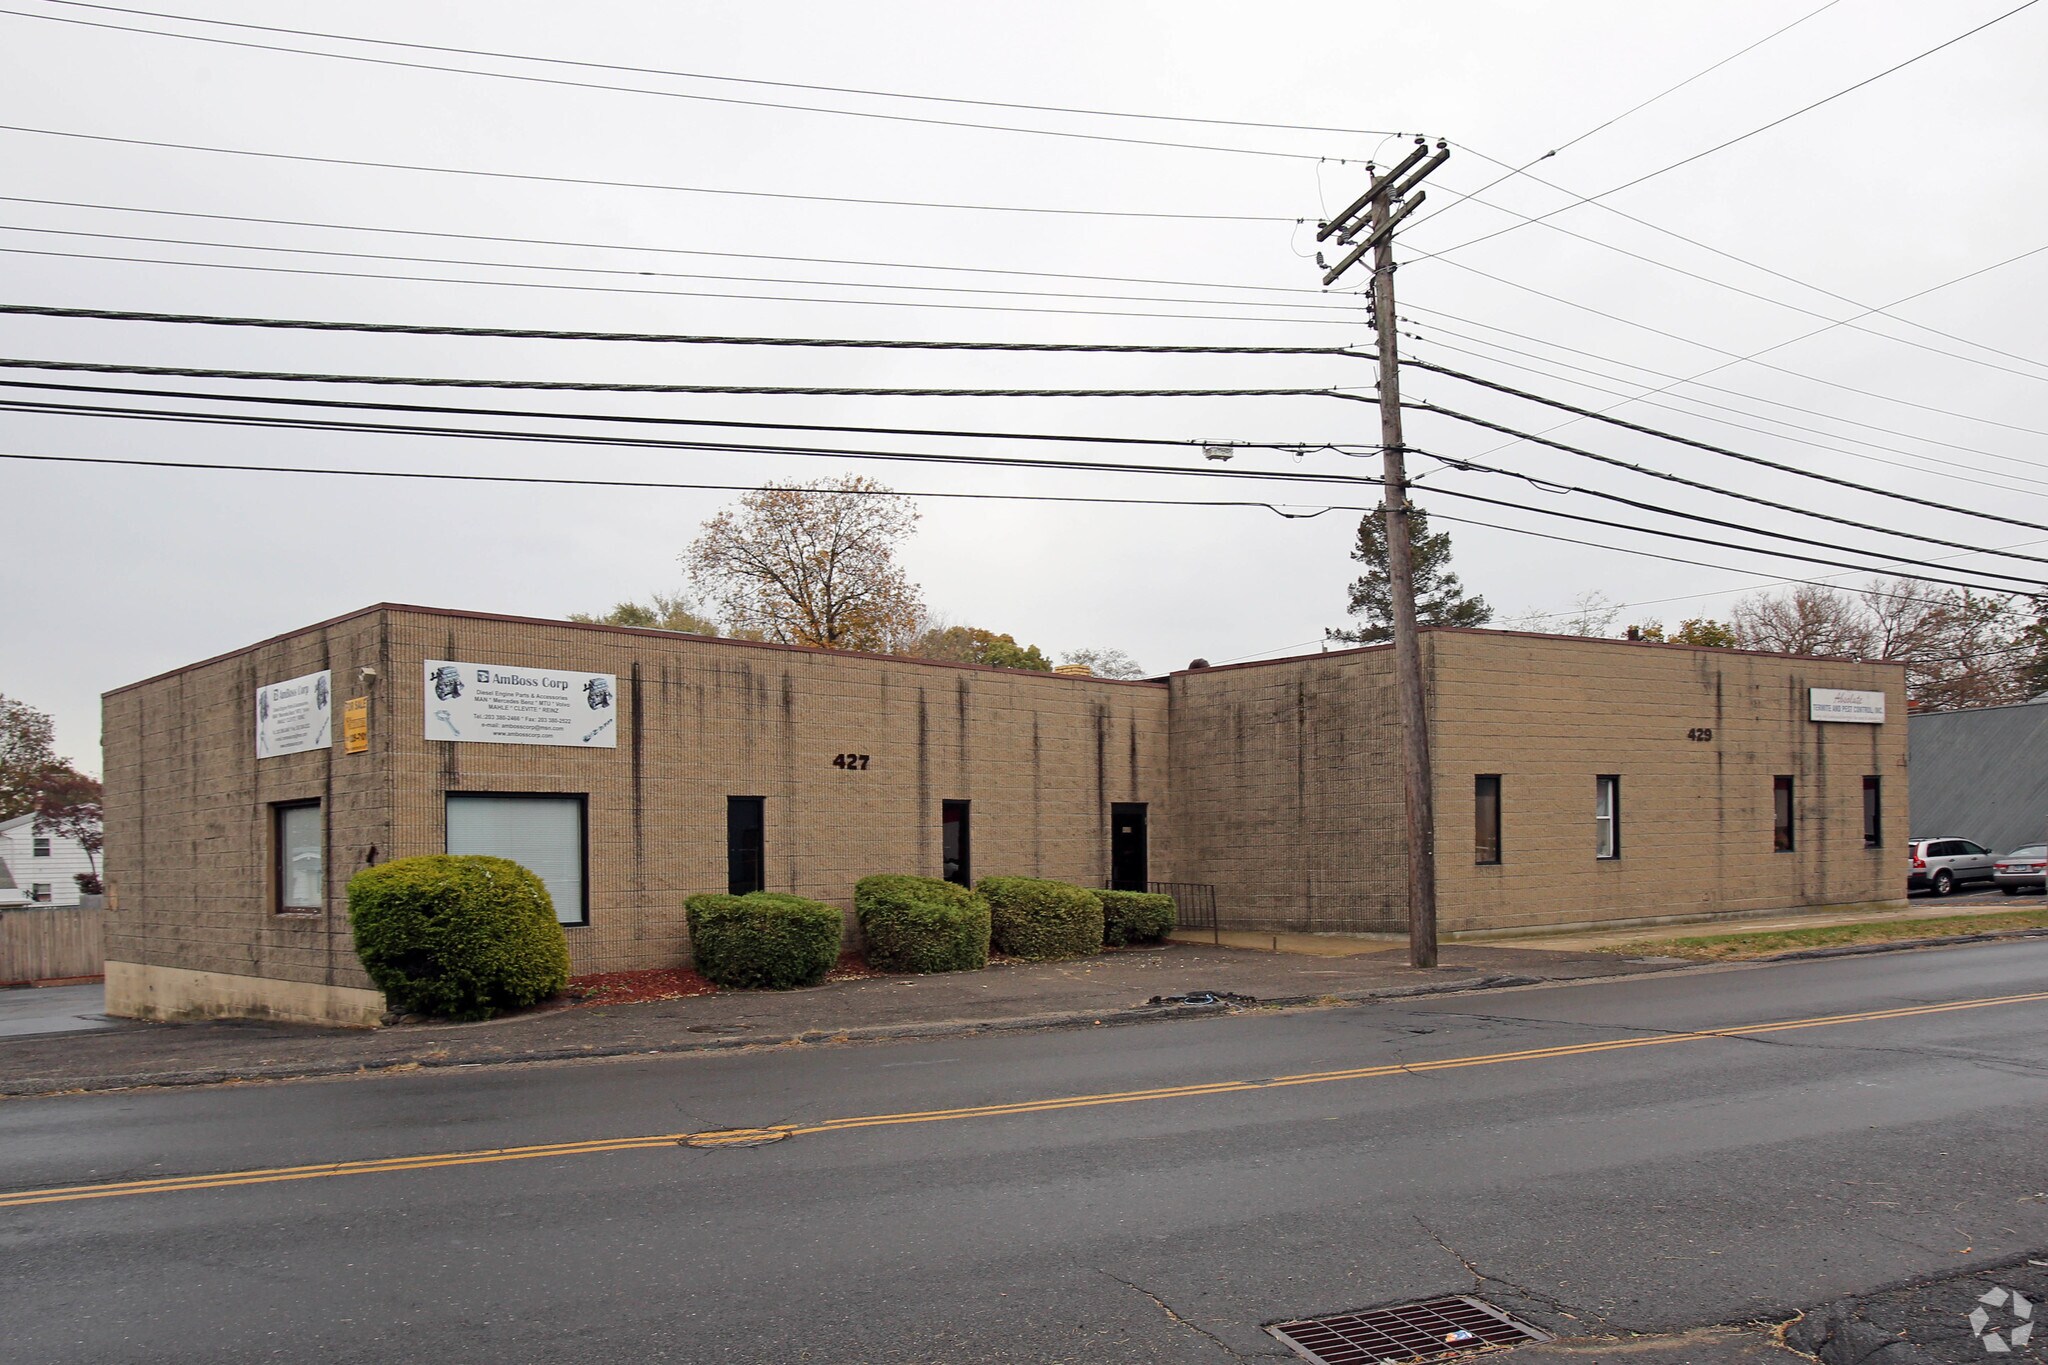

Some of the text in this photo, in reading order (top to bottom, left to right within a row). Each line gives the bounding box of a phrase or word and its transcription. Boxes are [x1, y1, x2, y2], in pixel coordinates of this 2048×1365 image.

[493, 673, 569, 690] AmBoss Corp
[493, 697, 520, 705] Mercedes
[513, 705, 538, 713] CLEVITE
[1687, 727, 1713, 742] 429
[832, 753, 870, 771] 427
